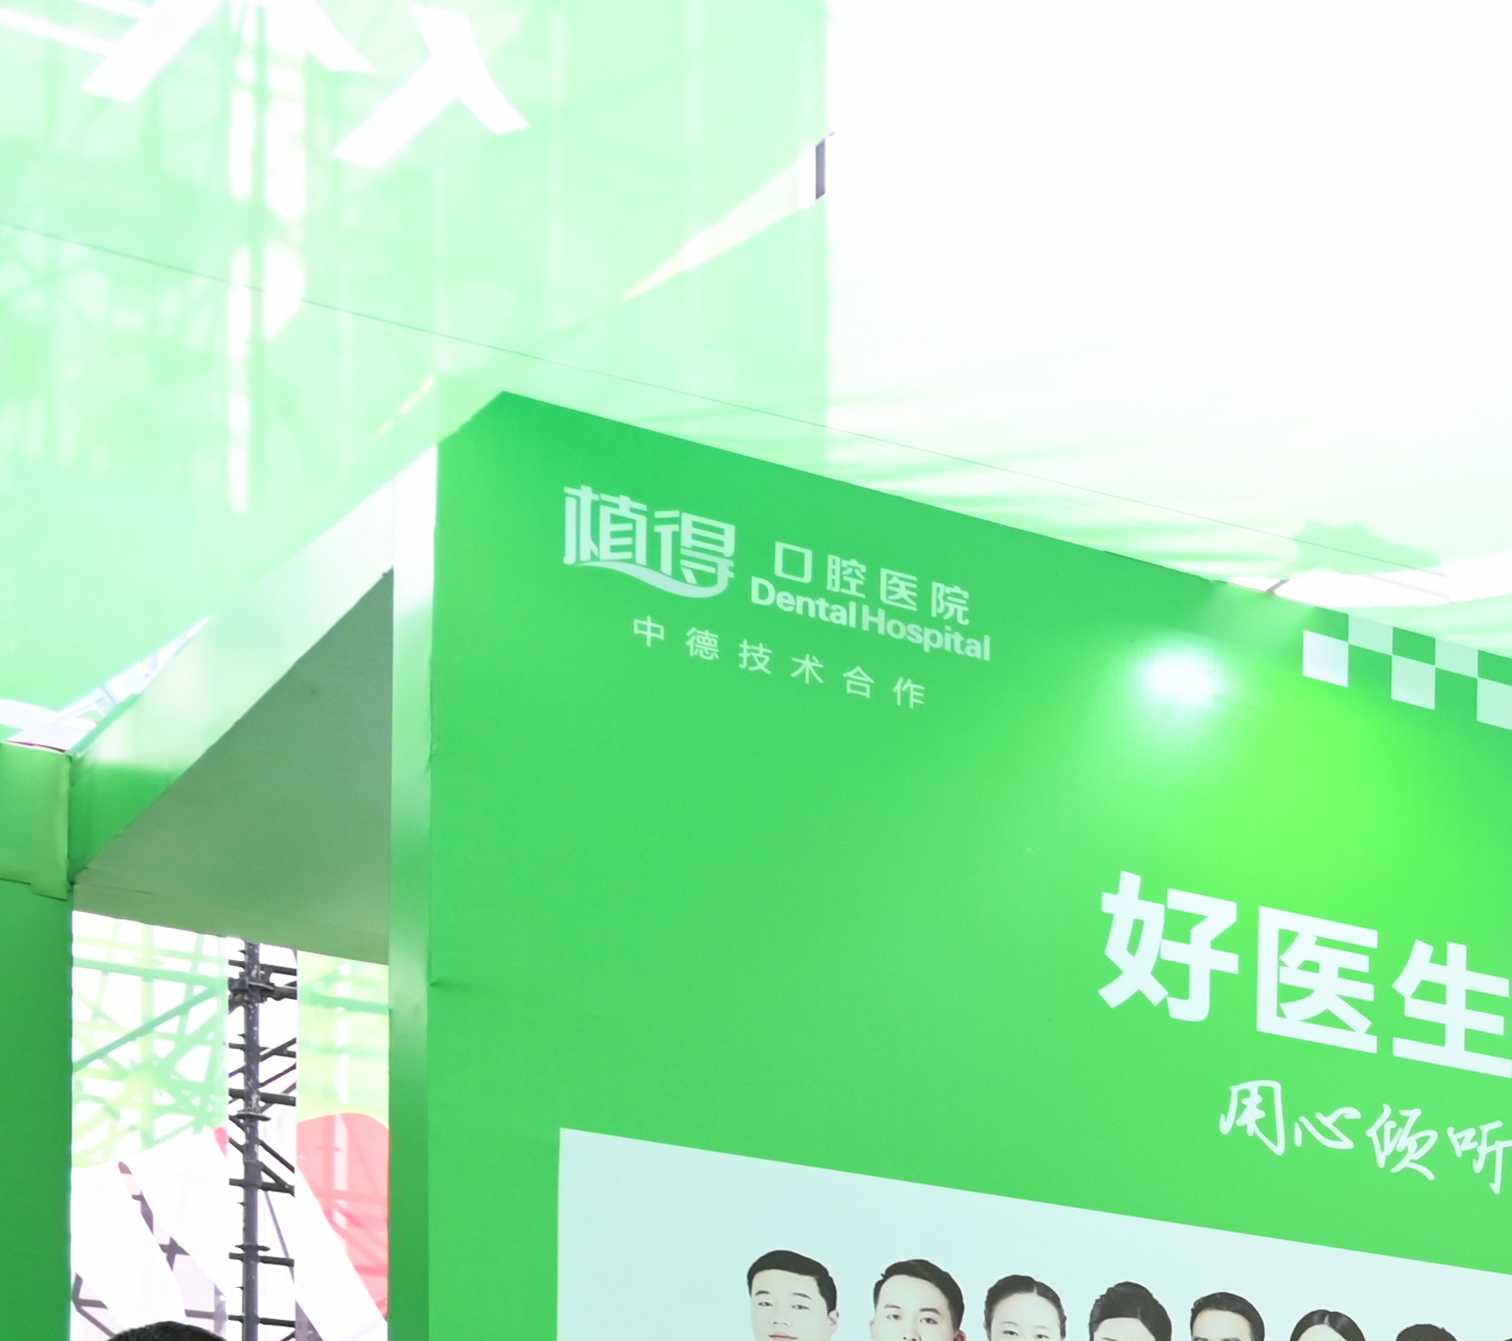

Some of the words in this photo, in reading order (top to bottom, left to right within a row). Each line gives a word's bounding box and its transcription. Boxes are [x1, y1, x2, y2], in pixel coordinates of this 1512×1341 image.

[563, 484, 736, 598] 植得
[775, 541, 970, 625] 口腔医院
[632, 615, 926, 709] 中德技术合作
[750, 576, 858, 631] Dental
[861, 609, 991, 662] Hospital
[1097, 870, 1512, 1078] 好医生
